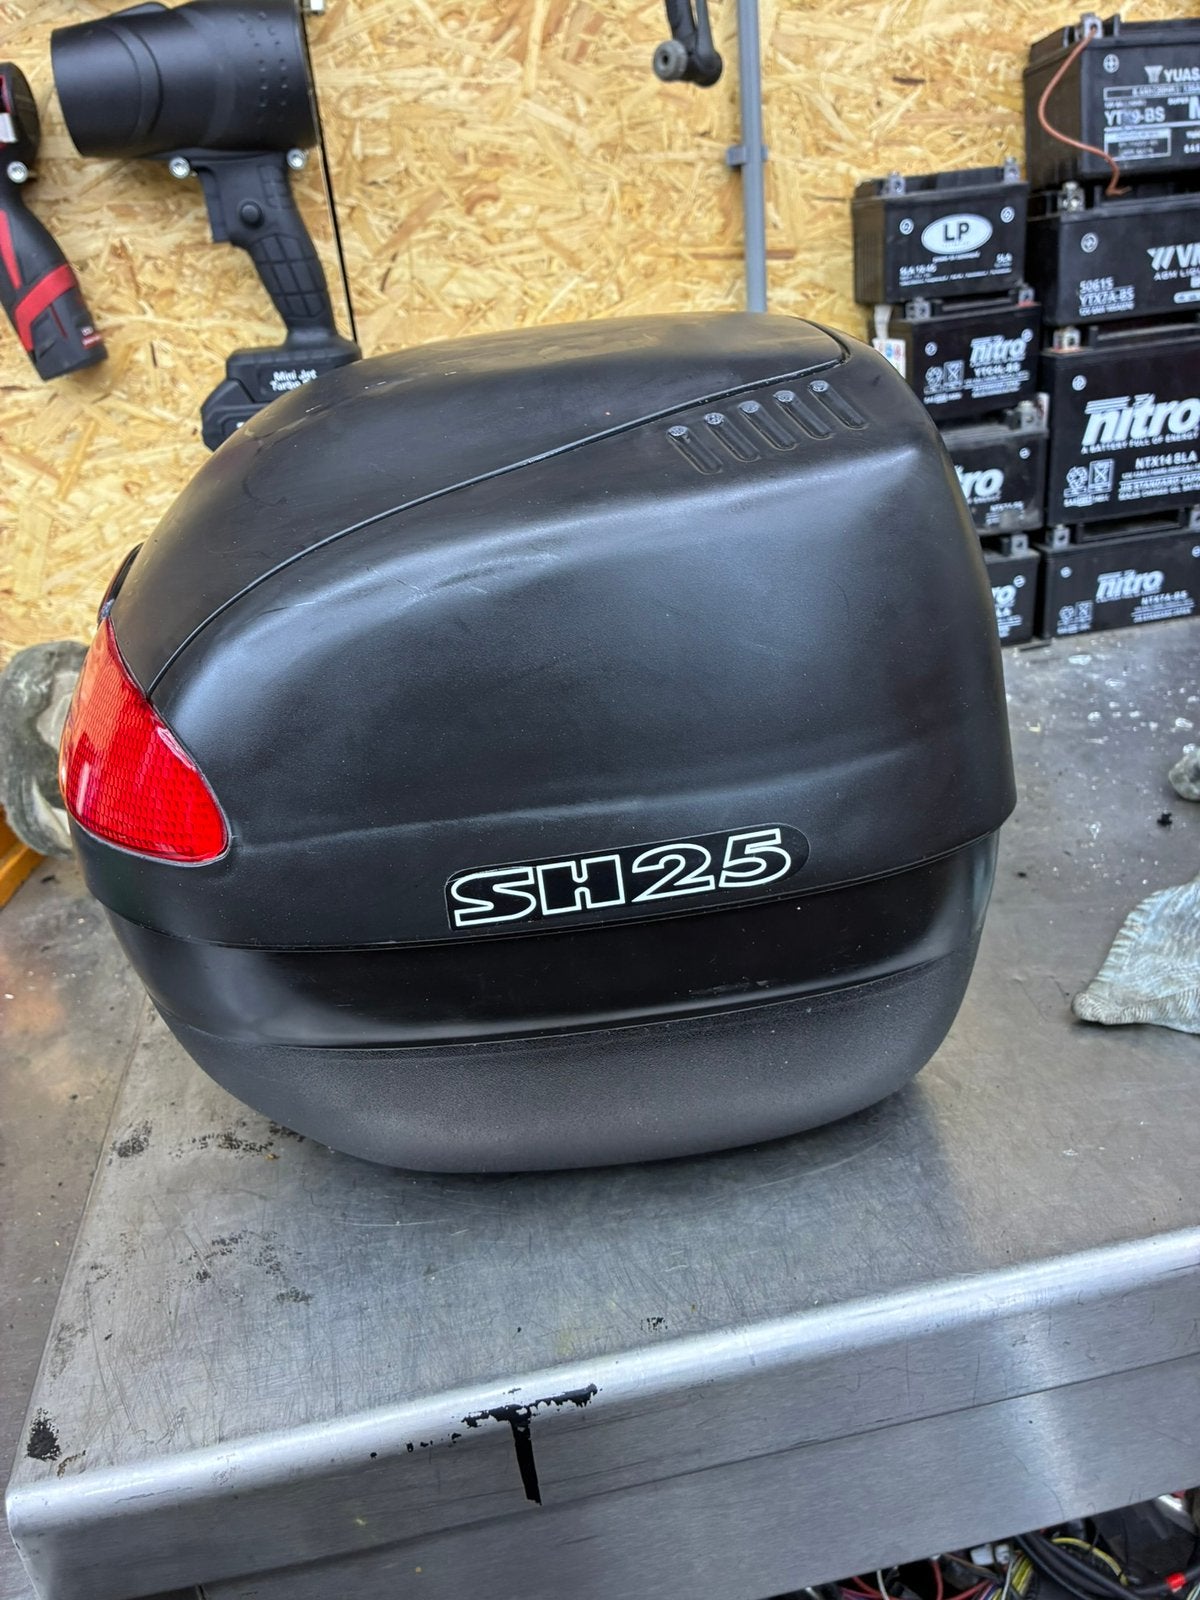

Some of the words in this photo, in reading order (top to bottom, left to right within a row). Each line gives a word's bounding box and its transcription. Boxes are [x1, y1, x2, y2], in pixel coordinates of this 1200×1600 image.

[944, 222, 970, 242] LP
[970, 335, 1026, 364] nitro
[1081, 393, 1200, 447] nitro
[1096, 569, 1164, 599] nitro
[451, 828, 792, 927] SH25
